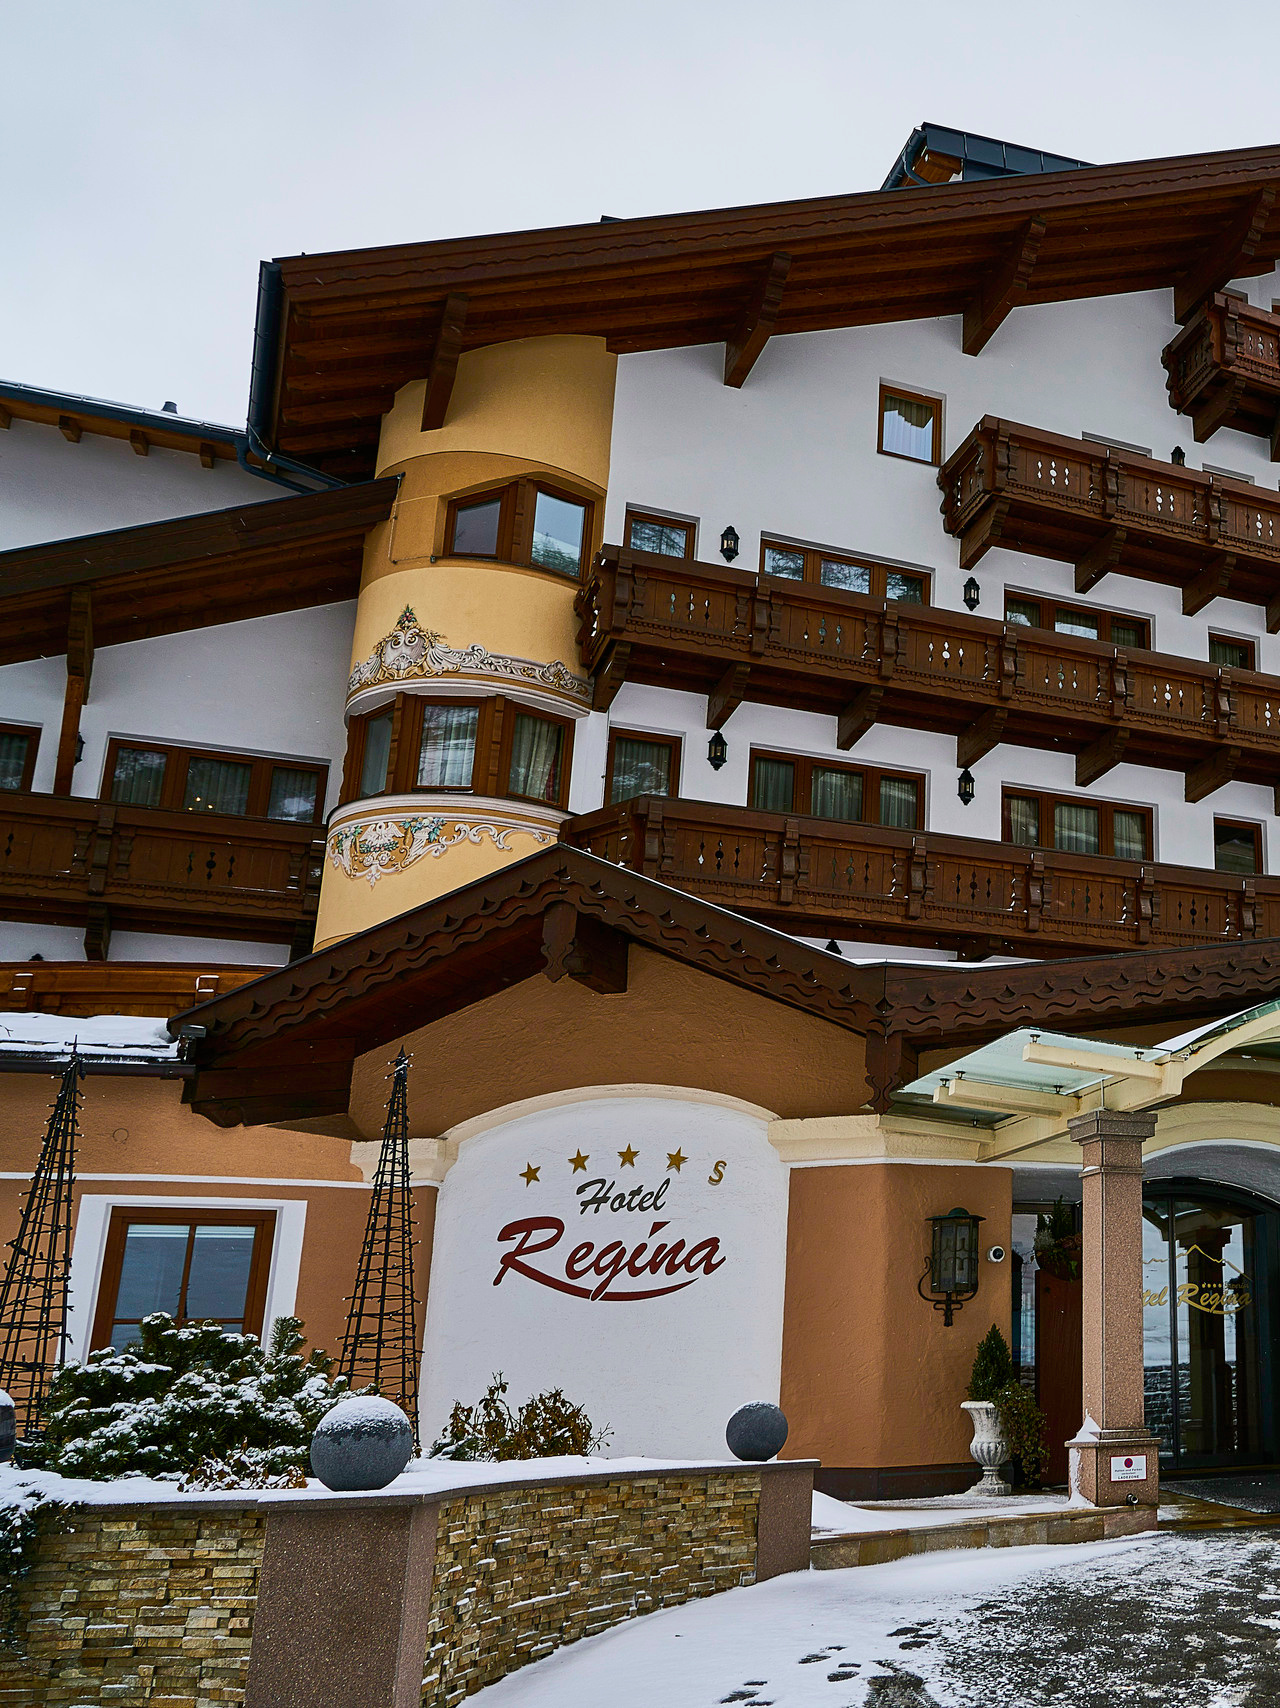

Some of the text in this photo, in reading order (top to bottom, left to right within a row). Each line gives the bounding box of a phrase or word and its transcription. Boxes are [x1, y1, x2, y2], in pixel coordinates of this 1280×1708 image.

[708, 1160, 727, 1186] S
[576, 1178, 671, 1215] Hotel
[493, 1216, 726, 1302] Regina
[1142, 1283, 1252, 1315] tel Regina
